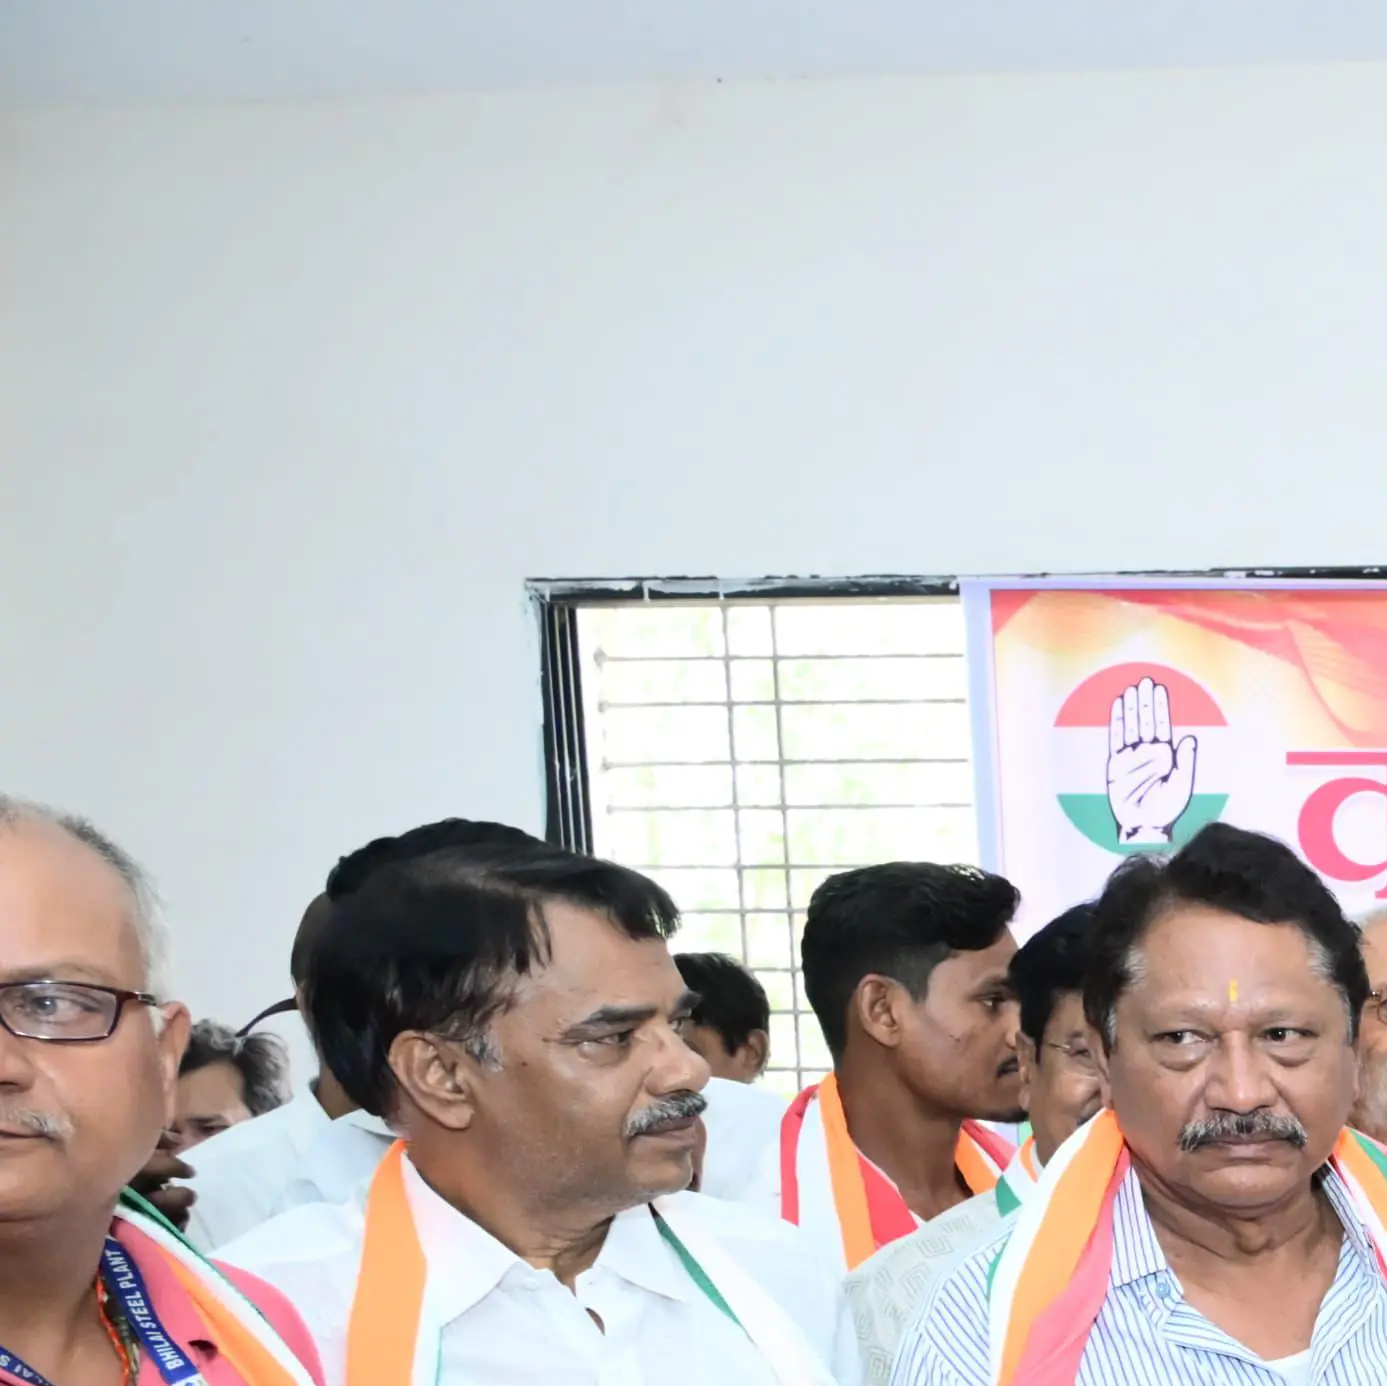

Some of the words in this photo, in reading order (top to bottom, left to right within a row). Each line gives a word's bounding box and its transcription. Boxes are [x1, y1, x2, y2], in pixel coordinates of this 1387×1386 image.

[105, 1249, 137, 1288] PLANT
[125, 1291, 157, 1328] STEEL
[145, 1330, 185, 1370] BHILAI
